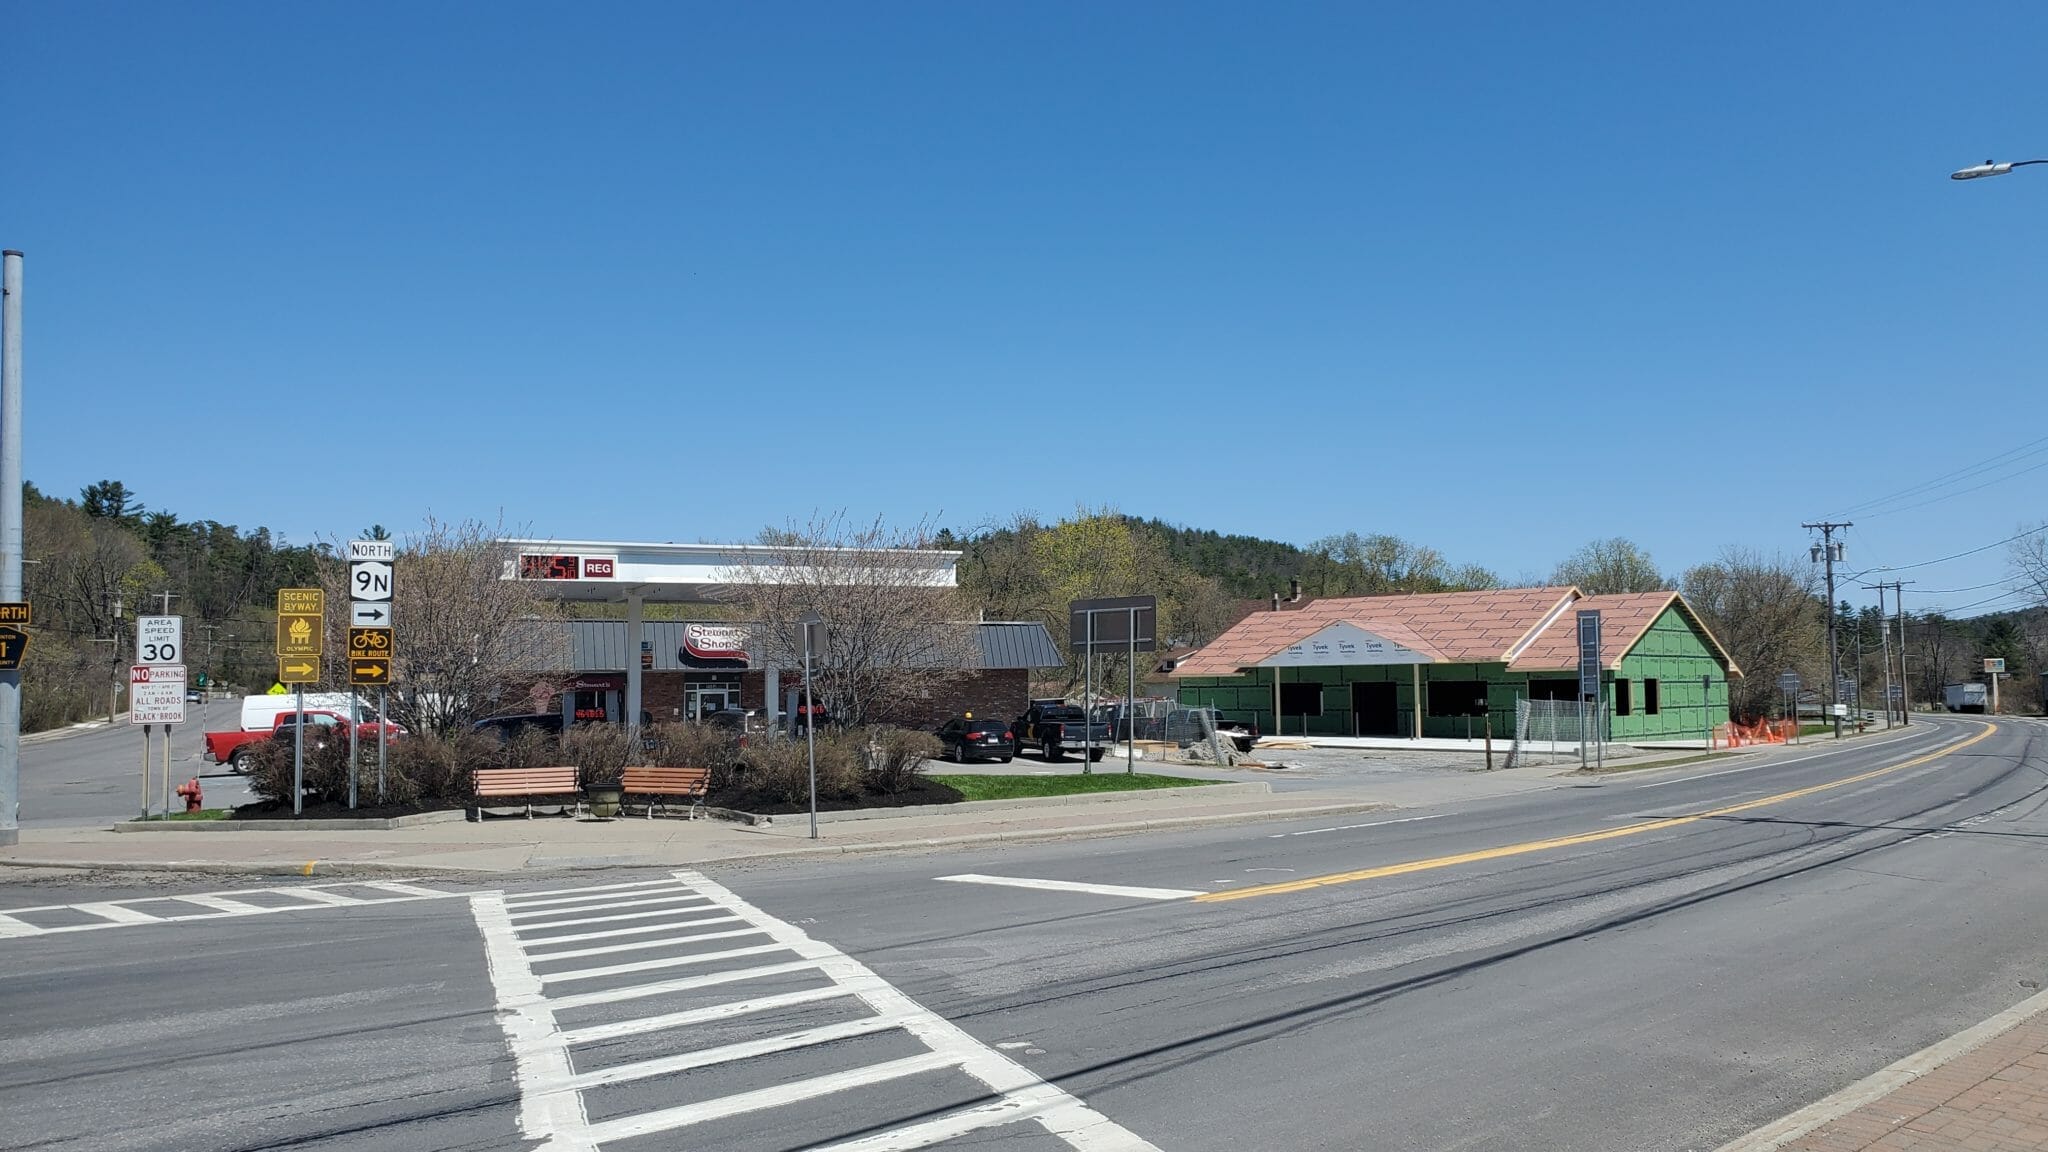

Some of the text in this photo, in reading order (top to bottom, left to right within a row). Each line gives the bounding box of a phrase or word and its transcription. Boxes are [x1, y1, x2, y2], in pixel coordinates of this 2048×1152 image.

[352, 544, 391, 557] NORTH
[586, 563, 611, 573] REG
[356, 571, 388, 592] 9N
[283, 592, 319, 601] SCENIC
[284, 602, 317, 611] BYWAY
[0, 606, 27, 619] RTH
[142, 643, 176, 661] 30
[132, 669, 185, 681] NO PARKING
[136, 697, 182, 705] ALL ROADS
[134, 712, 183, 721] BLACK BROOK
